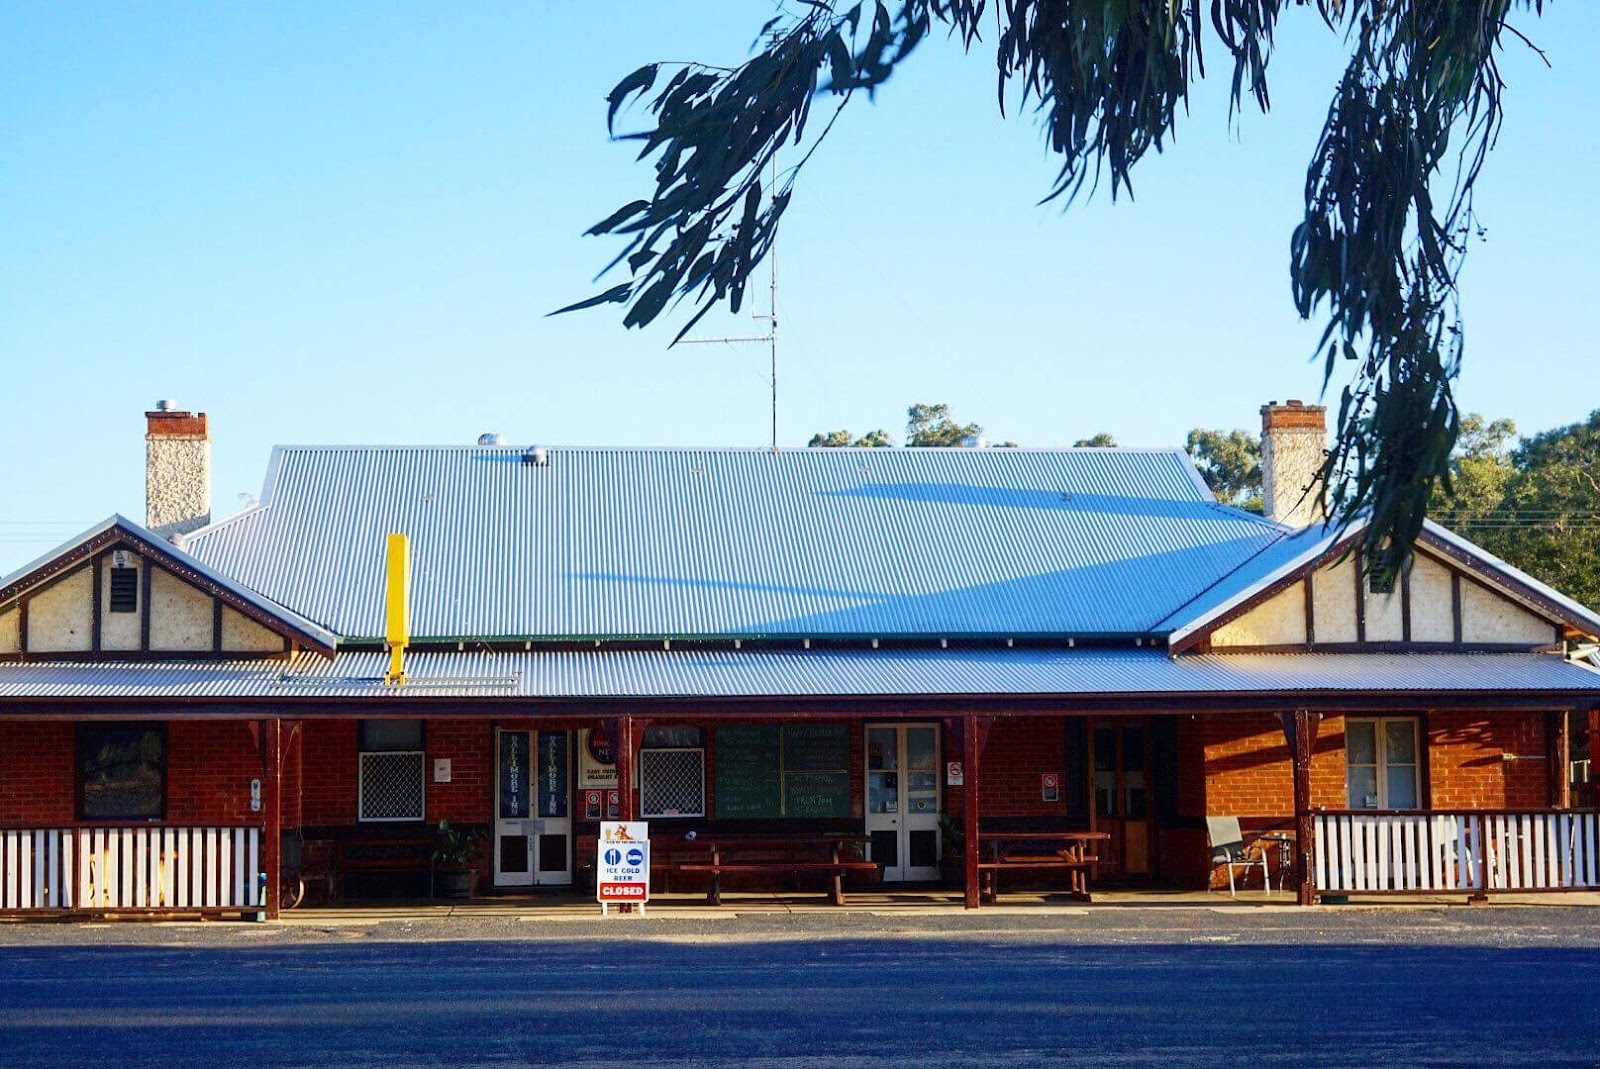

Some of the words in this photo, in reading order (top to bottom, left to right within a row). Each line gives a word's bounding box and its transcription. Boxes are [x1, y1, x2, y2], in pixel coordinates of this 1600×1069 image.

[598, 748, 610, 756] NE
[549, 794, 557, 815] INN
[602, 886, 643, 896] CLOSED
